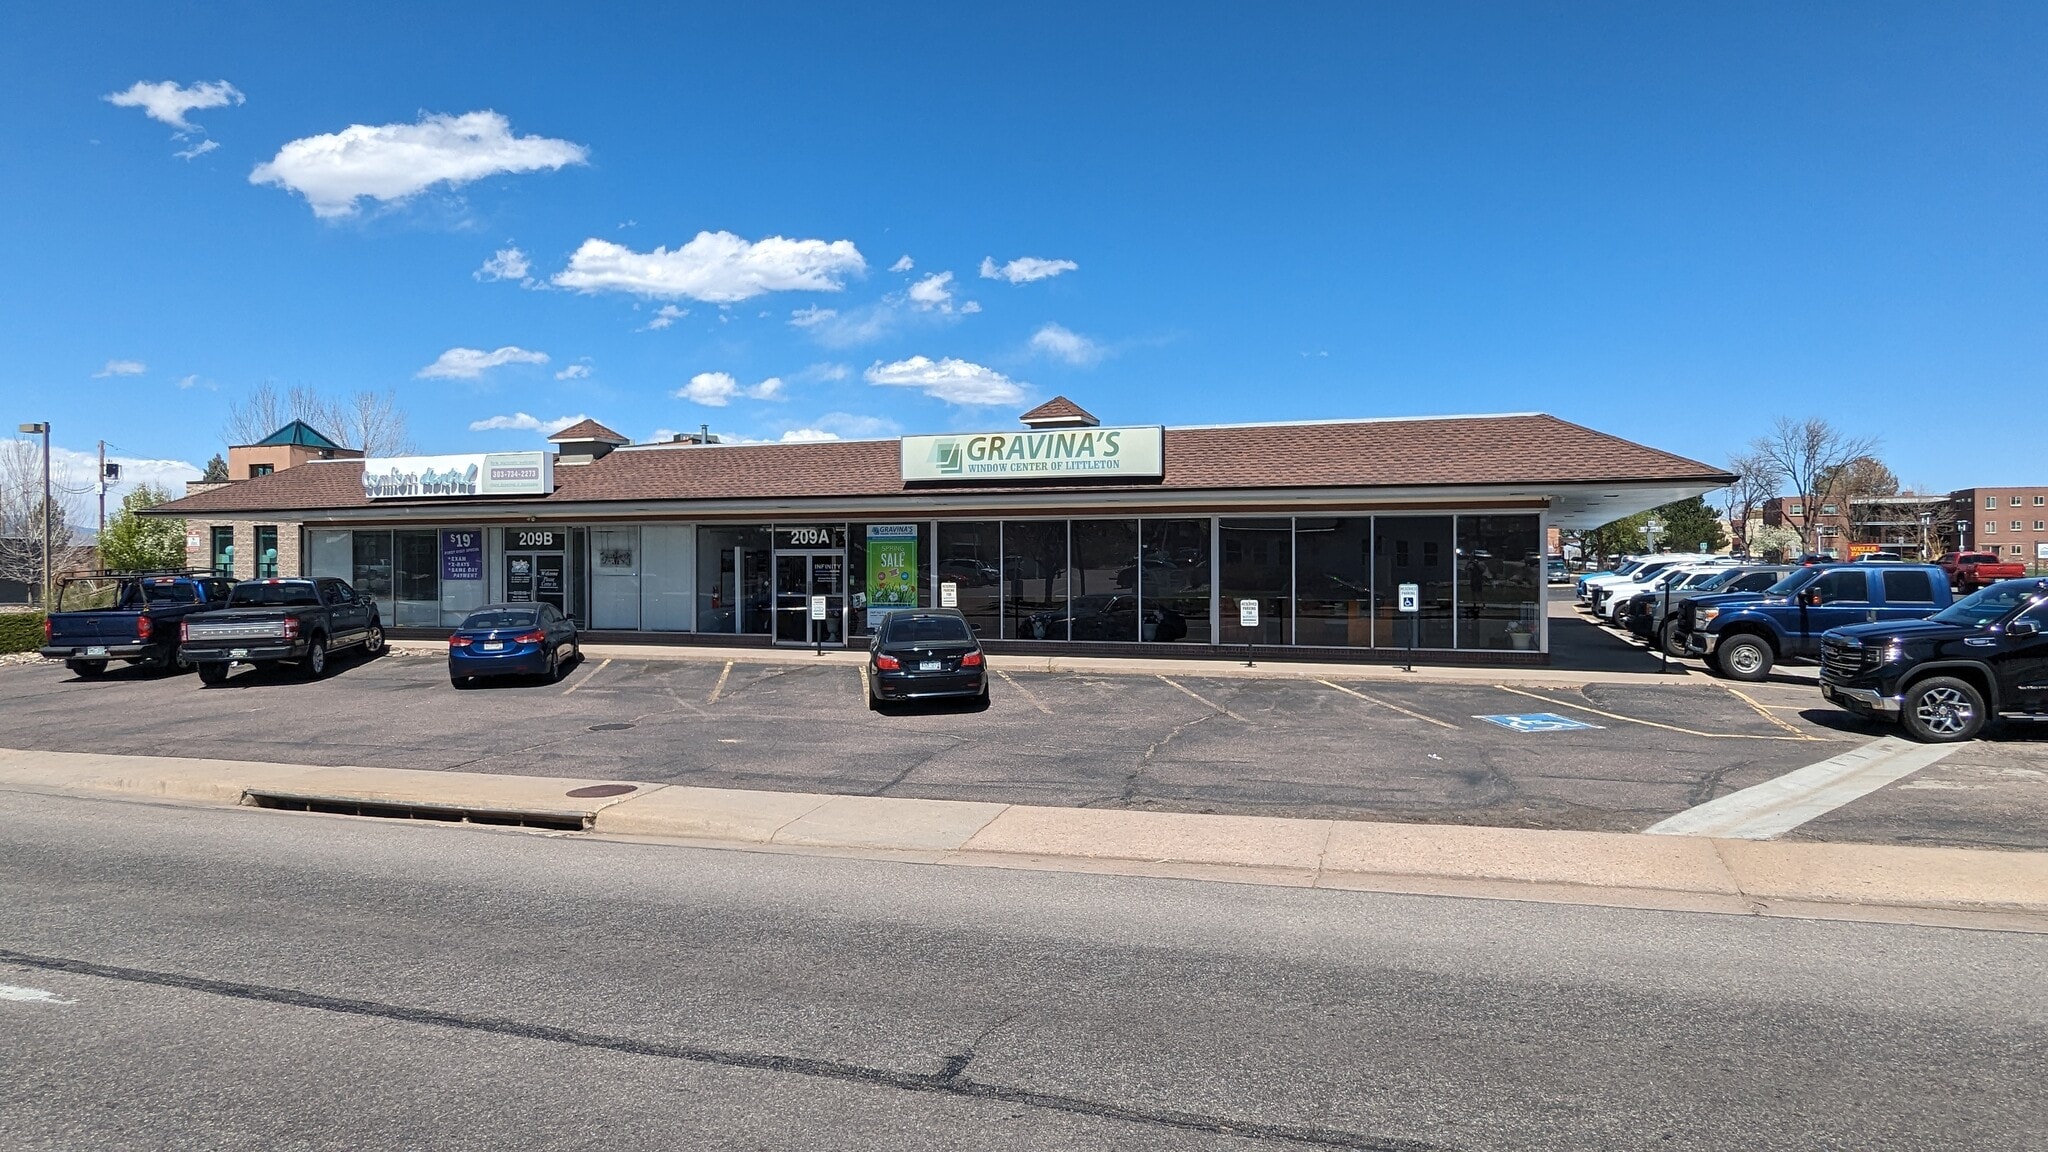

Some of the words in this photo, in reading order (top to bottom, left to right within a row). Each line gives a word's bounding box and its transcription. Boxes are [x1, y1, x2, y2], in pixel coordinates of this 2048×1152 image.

[967, 432, 1120, 461] GRAVINA'S
[968, 463, 1009, 473] WINDOW
[1010, 462, 1048, 472] CENTER
[1050, 461, 1062, 471] OF
[1065, 460, 1120, 470] LITTLETON
[492, 470, 536, 478] 303-734-2273
[519, 532, 553, 545] 209B
[790, 529, 830, 544] 209A
[881, 552, 905, 567] SALE
